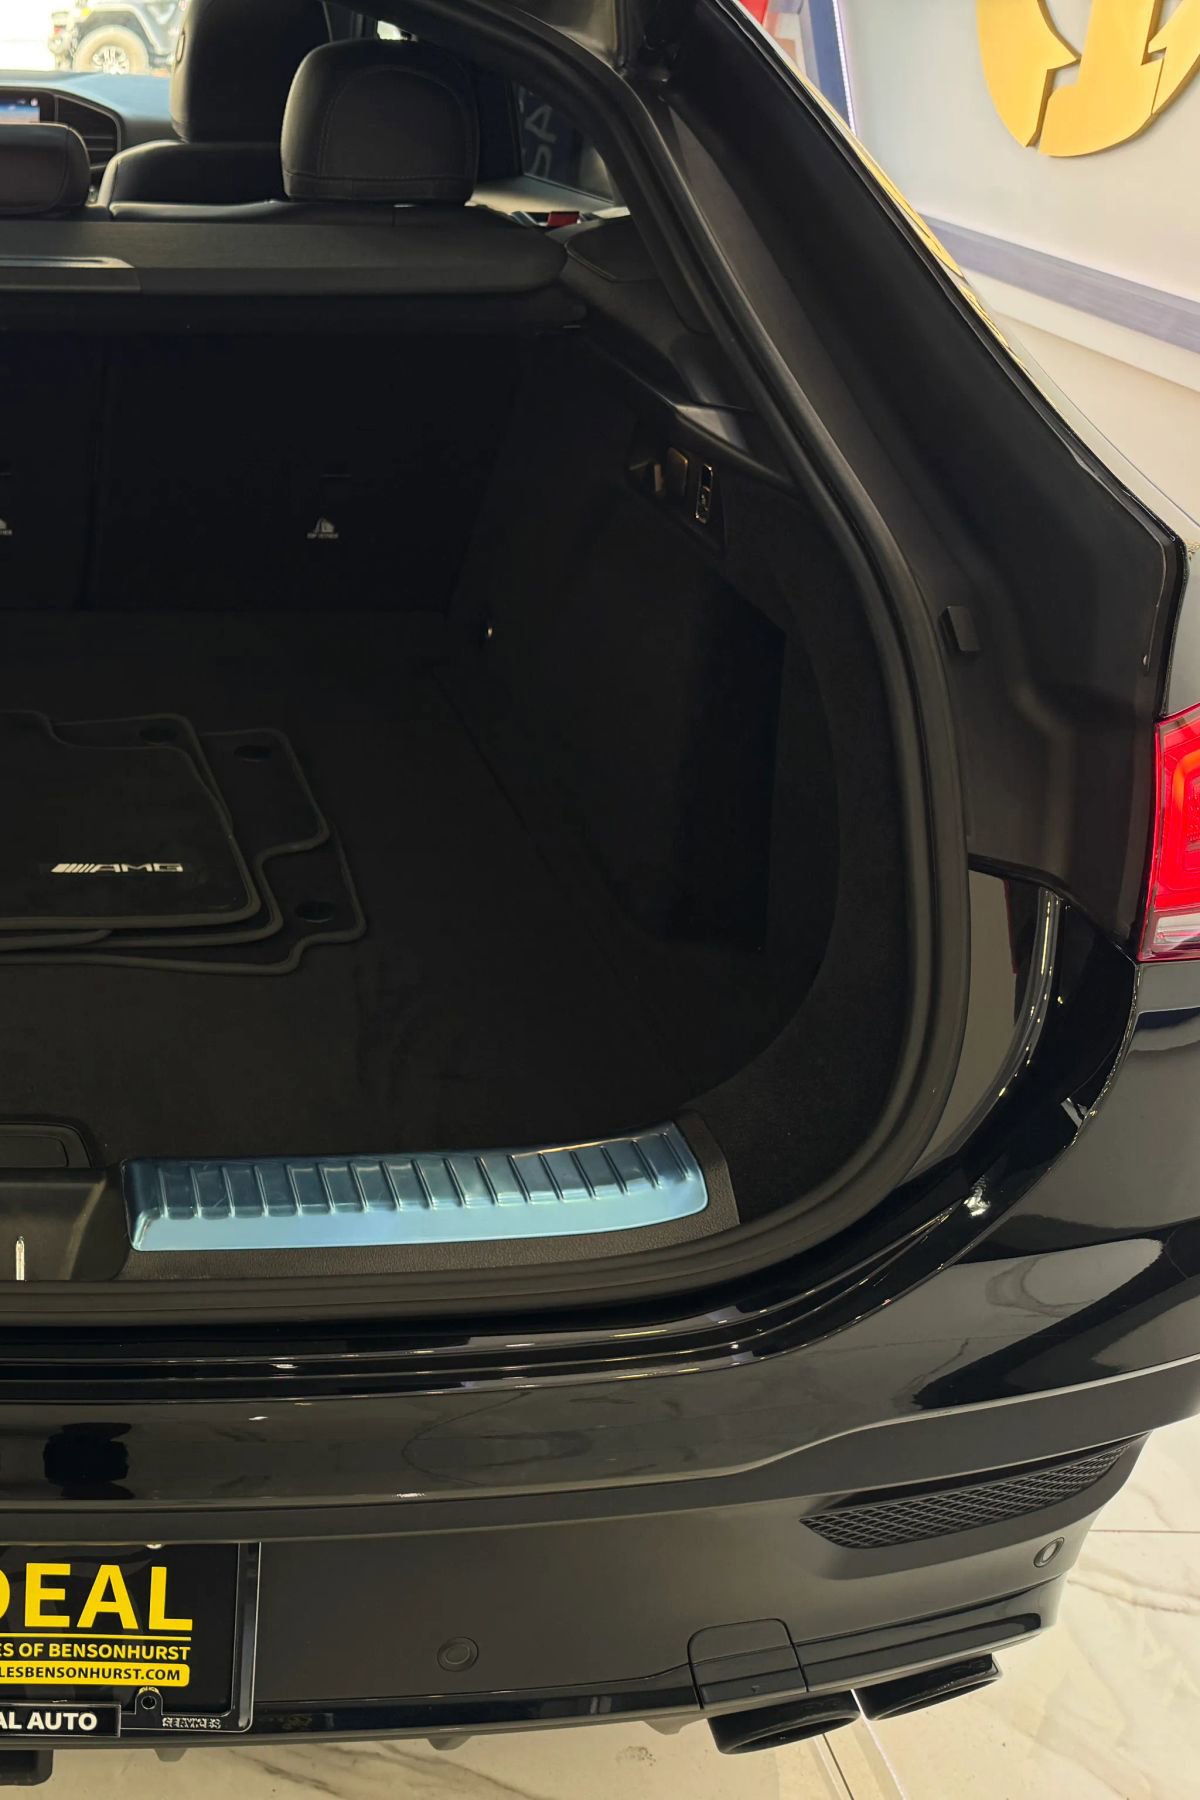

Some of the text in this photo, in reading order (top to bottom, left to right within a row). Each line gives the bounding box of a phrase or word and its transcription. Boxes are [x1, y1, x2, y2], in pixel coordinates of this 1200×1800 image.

[90, 863, 183, 873] AMG
[18, 1643, 44, 1657] OF
[49, 1643, 191, 1660] BENSONHURST
[27, 1711, 98, 1731] AUTO
